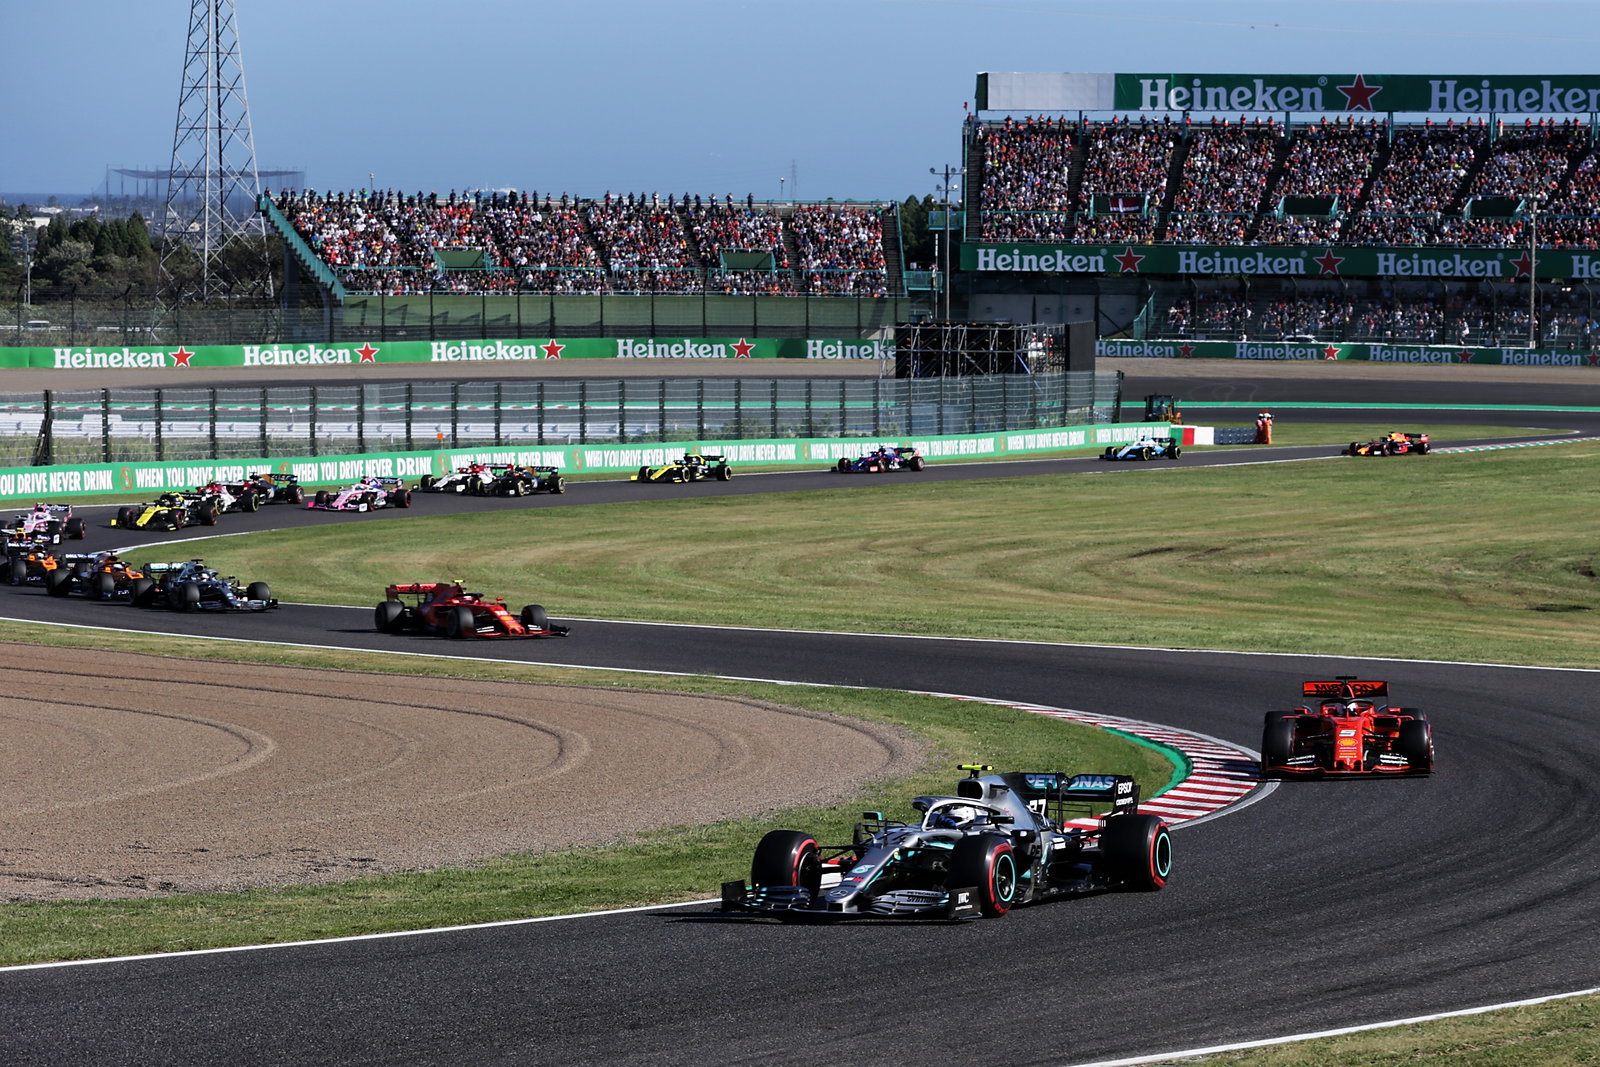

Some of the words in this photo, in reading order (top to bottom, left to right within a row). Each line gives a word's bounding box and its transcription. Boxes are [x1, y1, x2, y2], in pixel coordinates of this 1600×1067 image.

[1139, 79, 1325, 111] Heineken
[976, 249, 1105, 272] Heineken
[1178, 251, 1306, 275] Heineken
[1376, 253, 1502, 277] Heineken
[53, 347, 166, 368] Heineken
[243, 345, 352, 365] Heineken
[430, 341, 538, 362] Heineken
[616, 338, 727, 359] Heineken
[806, 339, 896, 360] Heineke
[1095, 341, 1175, 357] Heineken
[1235, 343, 1317, 360] Heineken
[1369, 346, 1452, 363] Heineken
[1502, 350, 1581, 366] Heineken
[518, 451, 541, 467] NEVER
[603, 450, 619, 467] YOU
[620, 449, 642, 466] DRIVE
[642, 448, 664, 466] NEVER
[135, 468, 164, 488] WHEN
[166, 467, 184, 487] YOU
[187, 466, 213, 487] DRIVE
[215, 466, 244, 482] NEVER
[292, 462, 318, 482] WHEN
[320, 461, 337, 481] YOU
[340, 460, 363, 479] DRIVE
[365, 458, 393, 478] NEVER
[396, 456, 432, 476] DRINK
[0, 474, 14, 496] OU
[17, 472, 48, 494] DRIVE
[49, 471, 82, 492] NEVER
[83, 470, 113, 491] DRINK
[1314, 683, 1376, 691] MISON
[1338, 729, 1357, 737] 5
[1025, 774, 1115, 789] PETONAS
[1117, 781, 1133, 795] EPSO
